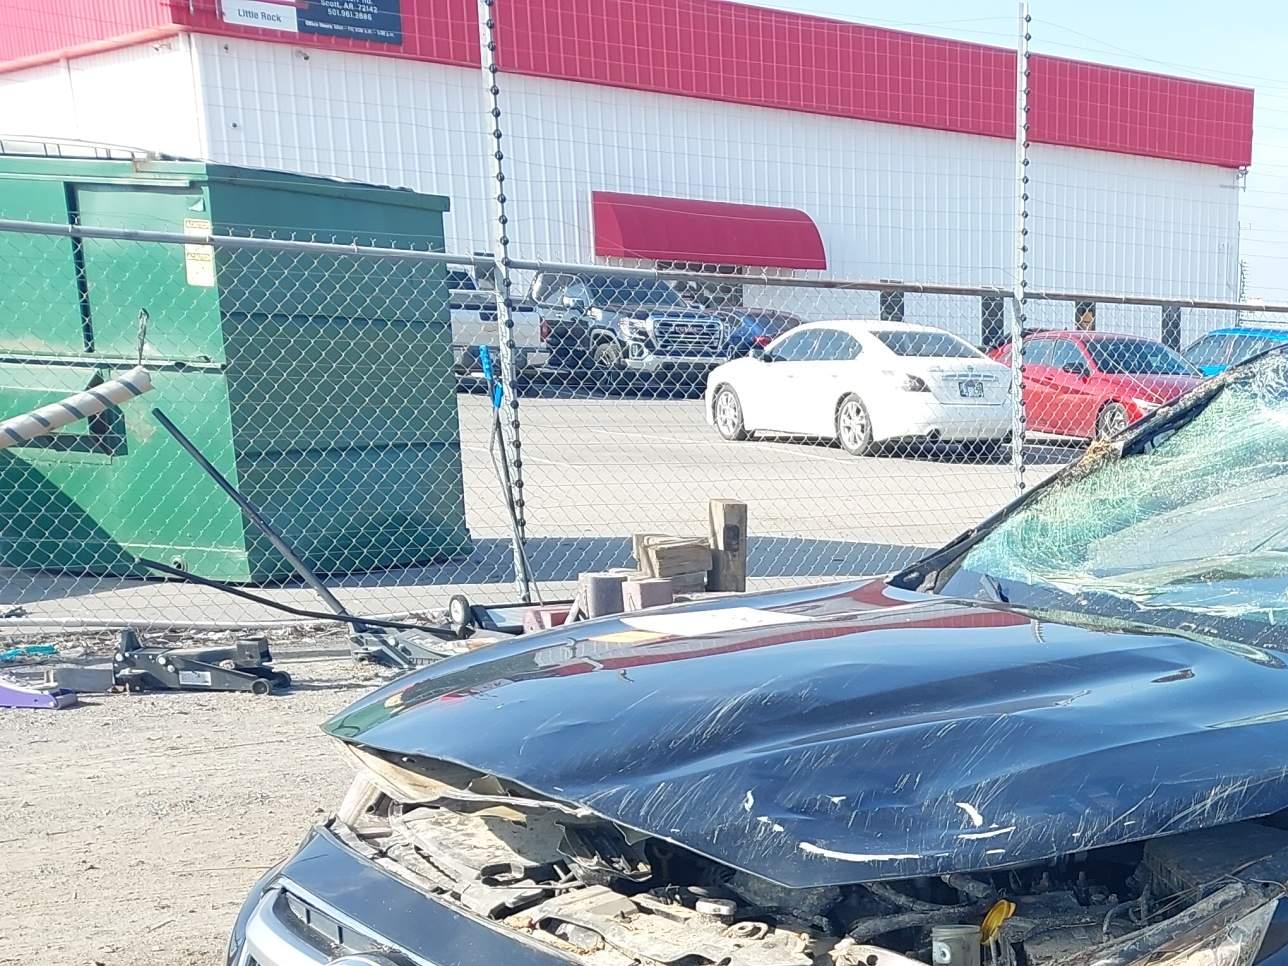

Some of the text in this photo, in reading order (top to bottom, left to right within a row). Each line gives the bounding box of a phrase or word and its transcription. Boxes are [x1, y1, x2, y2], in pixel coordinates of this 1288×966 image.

[237, 8, 282, 22] Little Rock
[357, 4, 378, 14] 72142
